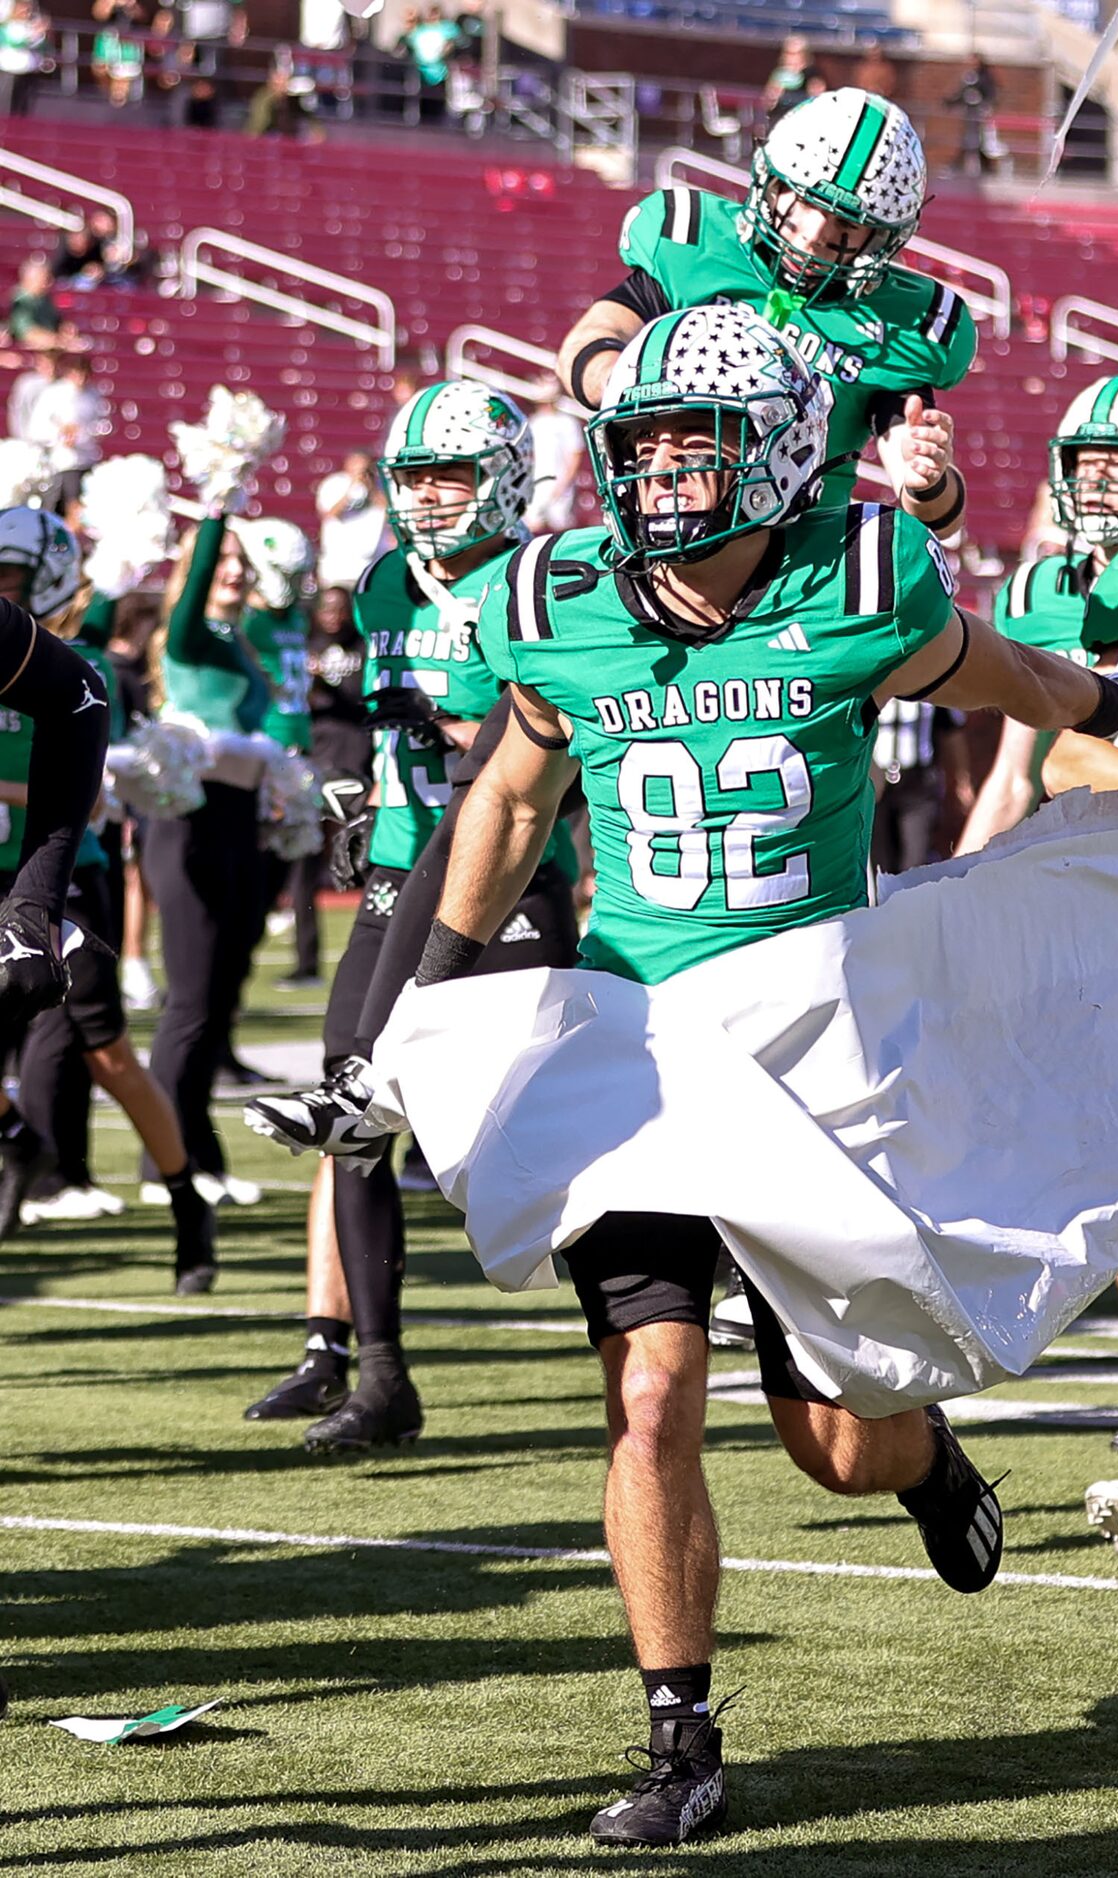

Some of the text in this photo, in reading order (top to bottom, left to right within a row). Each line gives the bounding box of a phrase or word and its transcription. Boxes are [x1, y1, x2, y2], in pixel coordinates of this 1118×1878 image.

[716, 295, 864, 384] GONS
[592, 677, 814, 734] DRAGONS
[617, 733, 814, 912] 82
